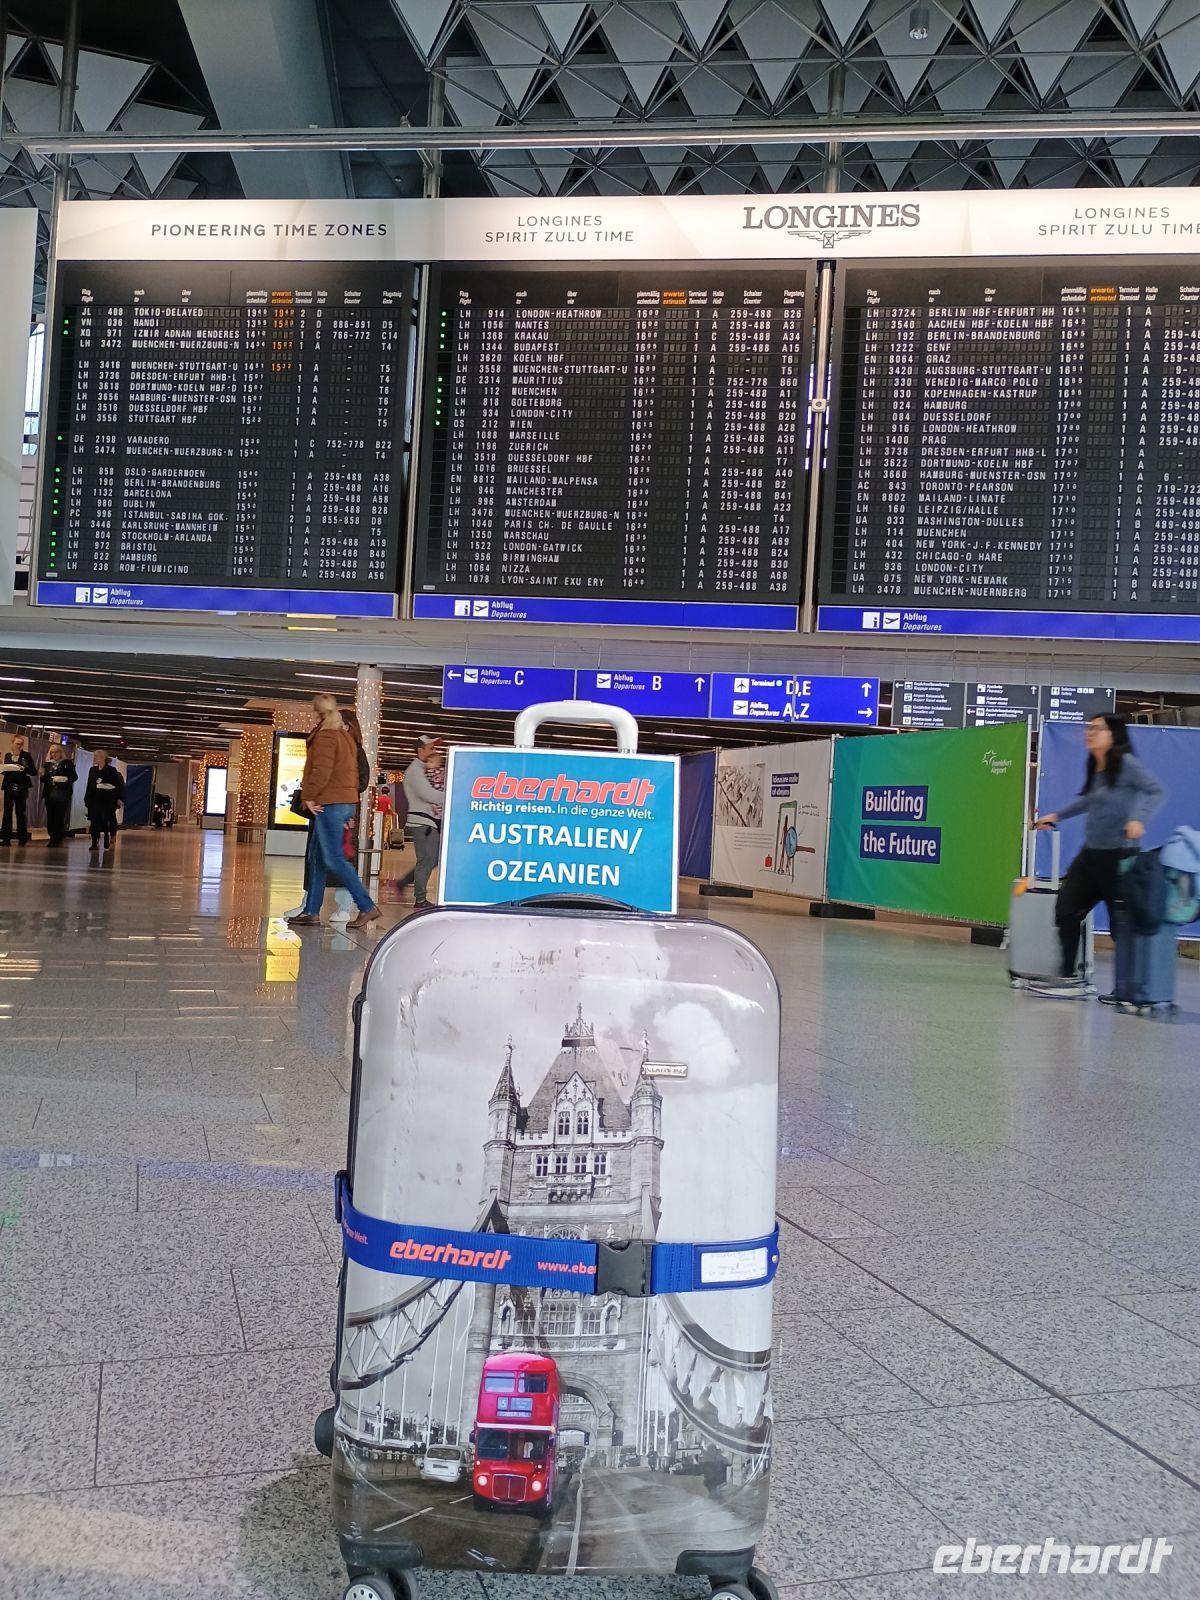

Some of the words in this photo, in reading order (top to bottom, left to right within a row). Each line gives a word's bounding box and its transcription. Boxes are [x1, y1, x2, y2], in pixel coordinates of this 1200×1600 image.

[743, 204, 920, 229] LONGINES
[1075, 207, 1170, 219] LONGINES
[518, 215, 603, 227] LONGINES
[152, 224, 266, 236] PIONEERING
[274, 224, 318, 236] TIME
[324, 224, 387, 236] ZONES
[1038, 224, 1096, 236] SPIRIT
[1105, 224, 1152, 235] ZULU
[485, 230, 538, 242] SPIRIT
[544, 230, 588, 242] ZULU
[594, 230, 634, 242] TIME
[134, 308, 203, 317] TOKIO-DELAYED
[516, 310, 602, 318] LONDON-HEATHROW
[730, 310, 771, 318] 259-488
[784, 310, 801, 318] B26
[929, 308, 966, 317] BERLIN
[972, 308, 1035, 317] HBF-ERFURT
[1042, 307, 1054, 316] HH
[134, 319, 159, 327] HANOI
[515, 321, 549, 329] NANTES
[928, 320, 965, 328] AACHEN
[972, 319, 1028, 328] HBF-KOELN
[1035, 319, 1053, 328] HBF
[134, 329, 159, 337] IZMIR
[164, 330, 191, 338] ADNAN
[197, 330, 239, 338] MENDERES
[515, 332, 549, 340] KRAKAU
[927, 331, 1040, 340] BERLIN-BRANDENBURG
[132, 340, 239, 349] MUENCHEN-WUERZBURG-N
[514, 343, 559, 351] BUDAPEST
[927, 343, 951, 352] GENF
[514, 354, 542, 362] KOELN
[548, 354, 564, 362] HBF
[926, 355, 950, 363] GRAZ
[131, 361, 238, 371] MUENCHEN-STUTTGART-U
[513, 365, 627, 374] MUENCHEN-STUTTGART-U
[925, 366, 1051, 375] AUGSBURG-STUTTGART-U
[130, 372, 205, 381] DRESDEN-ERFURT
[211, 373, 236, 381] HHB-L
[512, 376, 563, 384] MAURITIUS
[925, 378, 1006, 386] VENEDIG-MARCO
[1013, 378, 1038, 386] POLO
[130, 382, 204, 392] DORTMUND-KOELN
[210, 384, 237, 392] HBF-D
[512, 387, 557, 396] MUENCHEN
[924, 389, 1037, 398] KOPENHAGEN-KASTRUP
[129, 393, 236, 404] HAMBURG-MUENSTER-OSN
[511, 398, 562, 407] GOETEBORG
[129, 404, 186, 412] DUESSELDORF
[193, 405, 208, 413] HBF
[924, 401, 967, 410] HAMBURG
[511, 409, 573, 418] LONDON-CITY
[923, 412, 991, 421] DUESSELDORF
[128, 414, 176, 423] STUTTGART
[510, 420, 532, 428] WIEN
[923, 424, 1016, 433] LONDON-HEATHROW
[127, 436, 169, 444] VARADERO
[509, 431, 559, 440] MARSEILLE
[922, 436, 946, 444] PRAG
[509, 442, 548, 451] ZUERICH
[126, 447, 233, 456] MUENCHEN-WUERZBURG-N
[921, 447, 1008, 456] DRESDEN-ERFURT
[1016, 448, 1046, 457] HHB-L
[508, 453, 570, 462] DUESSELDORF
[576, 455, 592, 463] HBF
[921, 459, 1008, 468] DORTMUND-KOELN
[1015, 460, 1033, 468] HBF
[125, 468, 205, 477] OSLO-GARDERMOEN
[507, 464, 551, 473] BRUESSEL
[920, 471, 1046, 480] HAMBURG-MUENSTER-OSN
[124, 478, 220, 489] BERLIN-BRANDENBURG
[507, 476, 598, 485] MAILAND-MALPENSA
[920, 482, 1013, 491] TORONTO-PEARSON
[124, 489, 171, 498] BARCELONA
[506, 487, 562, 496] MANCHESTER
[506, 498, 556, 507] AMSTERDAM
[919, 493, 1005, 503] MAILAND-LINATE
[123, 500, 155, 508] DUBLIN
[505, 509, 619, 520] MUENCHEN-WUERZBURG-N
[918, 505, 998, 515] LEIPZIG/HALLE
[124, 510, 202, 521] ISTANBUL-SABIHA
[122, 521, 218, 532] KARLSRUHE-MANNHEIM
[504, 520, 532, 529] PARIS
[538, 521, 554, 529] CH.
[561, 521, 572, 530] DE
[579, 521, 612, 530] GAULLE
[918, 517, 1024, 527] WASHINGTON-DULLES
[504, 531, 549, 540] WARSCHAU
[917, 528, 966, 537] MUENCHEN
[121, 532, 212, 543] STOCKHOLM-ARLANDA
[121, 542, 157, 551] BRISTOL
[504, 542, 582, 553] LONDON-GATWICK
[916, 540, 935, 548] NEW
[942, 540, 1042, 550] YORK-J.F.KENNEDY
[120, 553, 157, 562] HAMBURG
[503, 553, 559, 563] BIRMINGHAM
[916, 551, 972, 561] CHICAGO-O
[978, 553, 1002, 562] HARE
[119, 563, 188, 573] ROM-FIUMICINO
[502, 564, 530, 573] NIZZA
[916, 563, 983, 572] LONDON-CITY
[502, 575, 558, 585] LYON-SAINT
[914, 575, 933, 583] NEW
[940, 575, 1008, 585] YORK-NEWARK
[111, 588, 131, 596] Abflug
[914, 586, 1027, 597] MUENCHEN-NUERNBERG
[110, 597, 143, 605] Departures
[491, 610, 527, 619] Departures
[903, 613, 927, 622] Abflug
[903, 623, 942, 632] Departures
[481, 669, 500, 677] Abflug
[480, 677, 511, 686] Departures
[514, 671, 524, 686] C
[614, 674, 633, 683] Abflug
[652, 676, 661, 690] B
[614, 682, 645, 691] Departures
[471, 772, 655, 806] eberhardt
[866, 790, 923, 819] Building
[471, 802, 512, 814] Richtig
[515, 804, 555, 814] reisen.
[558, 803, 567, 814] In
[571, 805, 588, 815] die
[591, 807, 624, 818] ganze
[627, 808, 654, 820] Welt.
[468, 823, 642, 854] AUSTRALIEN/
[863, 831, 885, 853] the
[889, 833, 936, 856] Future
[487, 860, 620, 886] OZEANIEN
[390, 1240, 511, 1270] eberhardt
